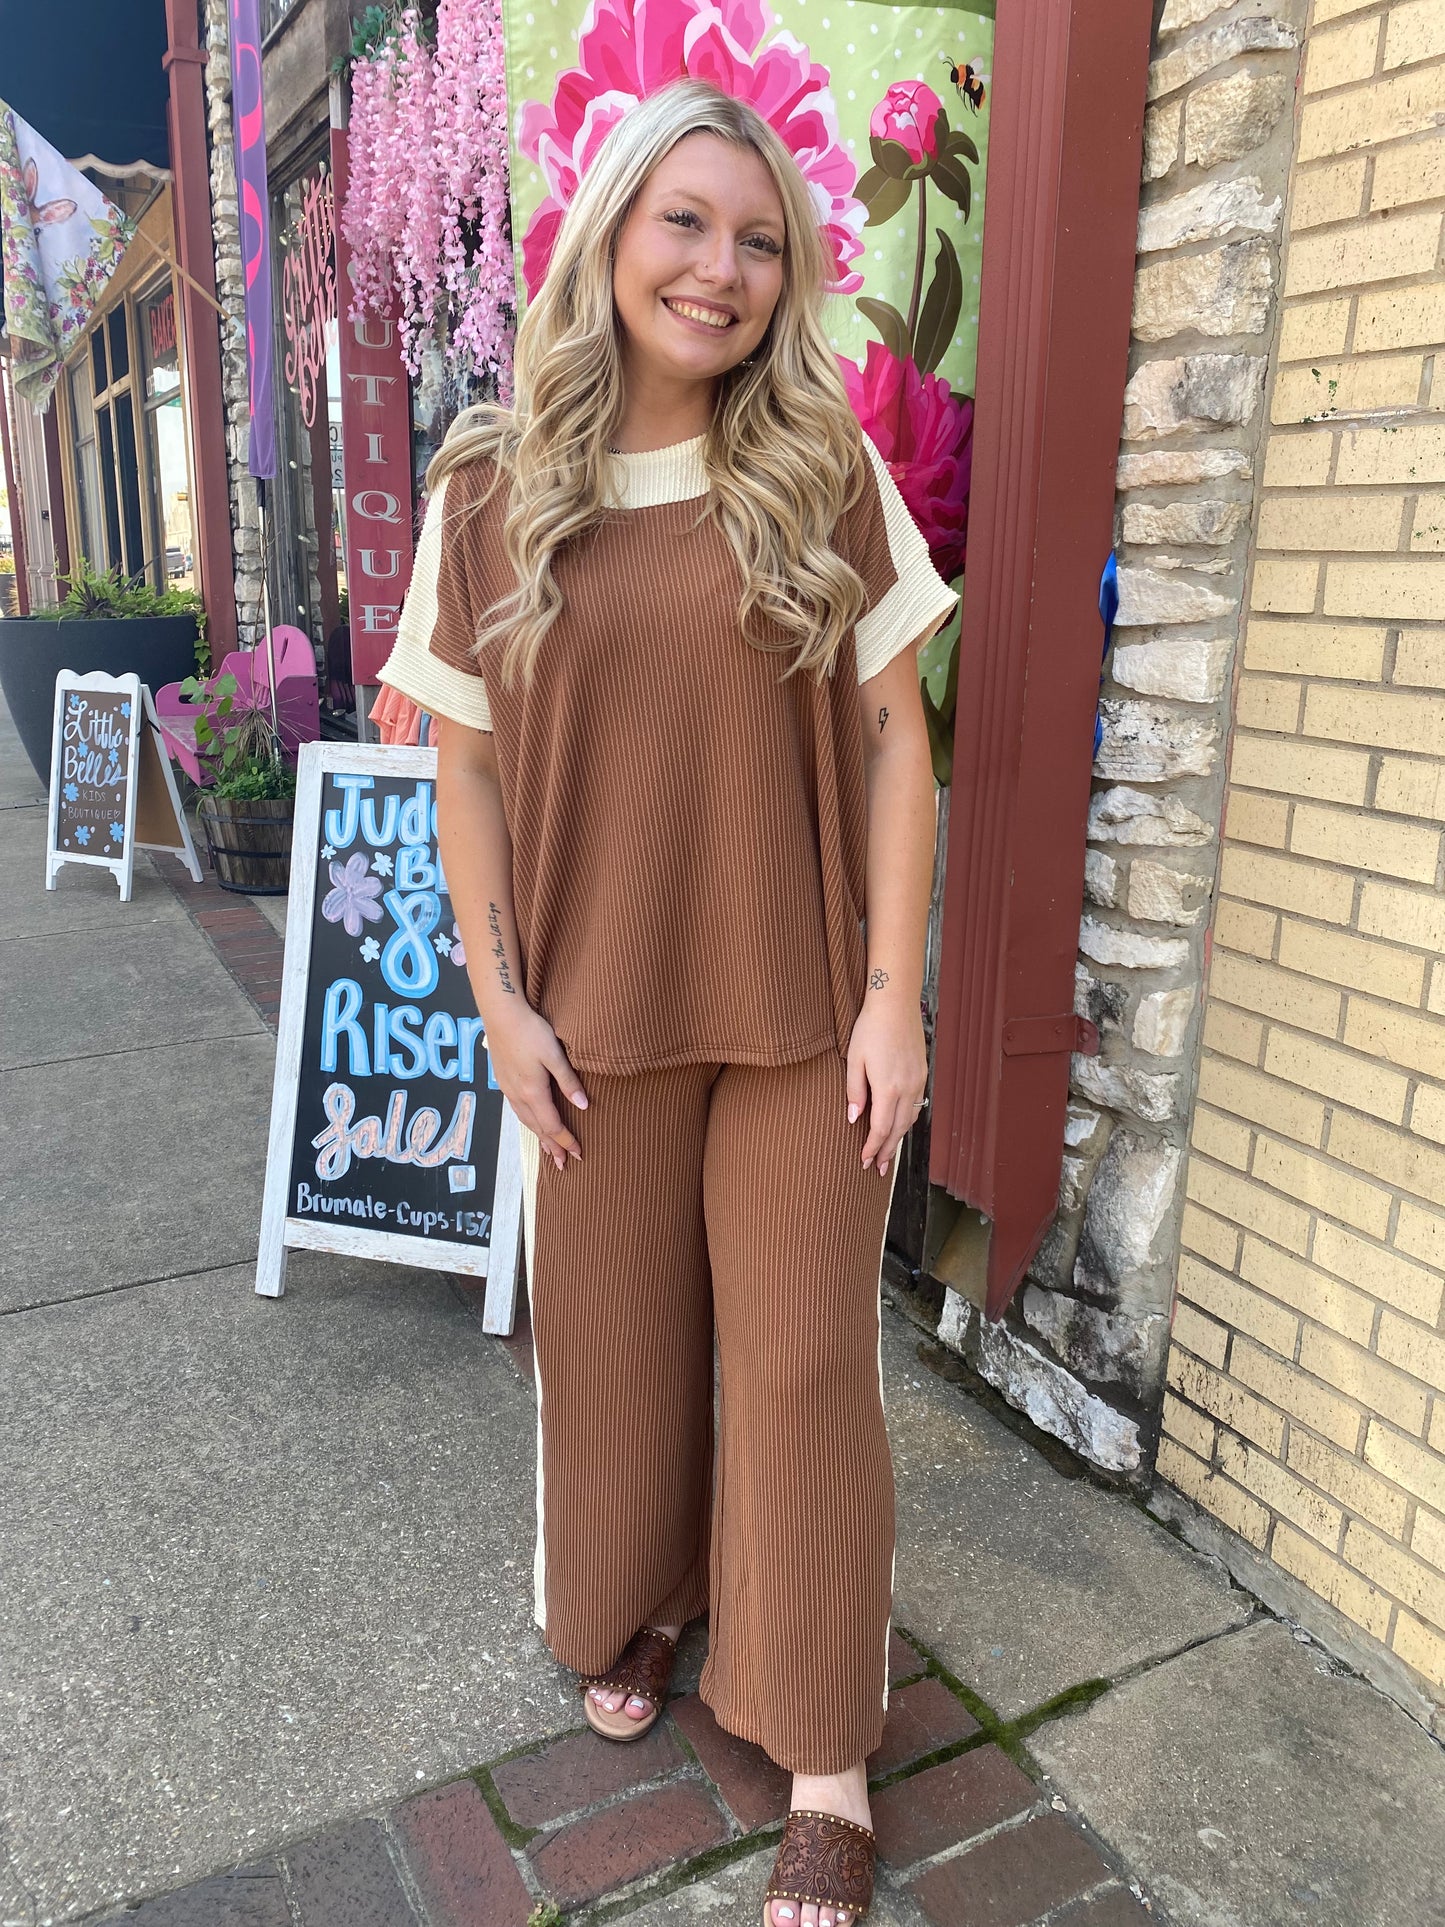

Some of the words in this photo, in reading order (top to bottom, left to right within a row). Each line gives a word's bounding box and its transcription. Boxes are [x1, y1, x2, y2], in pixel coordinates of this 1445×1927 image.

[63, 700, 124, 749] Little
[82, 789, 106, 802] KIDS
[67, 806, 112, 820] BOUTIQUE
[489, 902, 501, 914] go
[488, 913, 497, 923] it
[499, 970, 509, 980] it
[311, 1082, 477, 1194] Sale!
